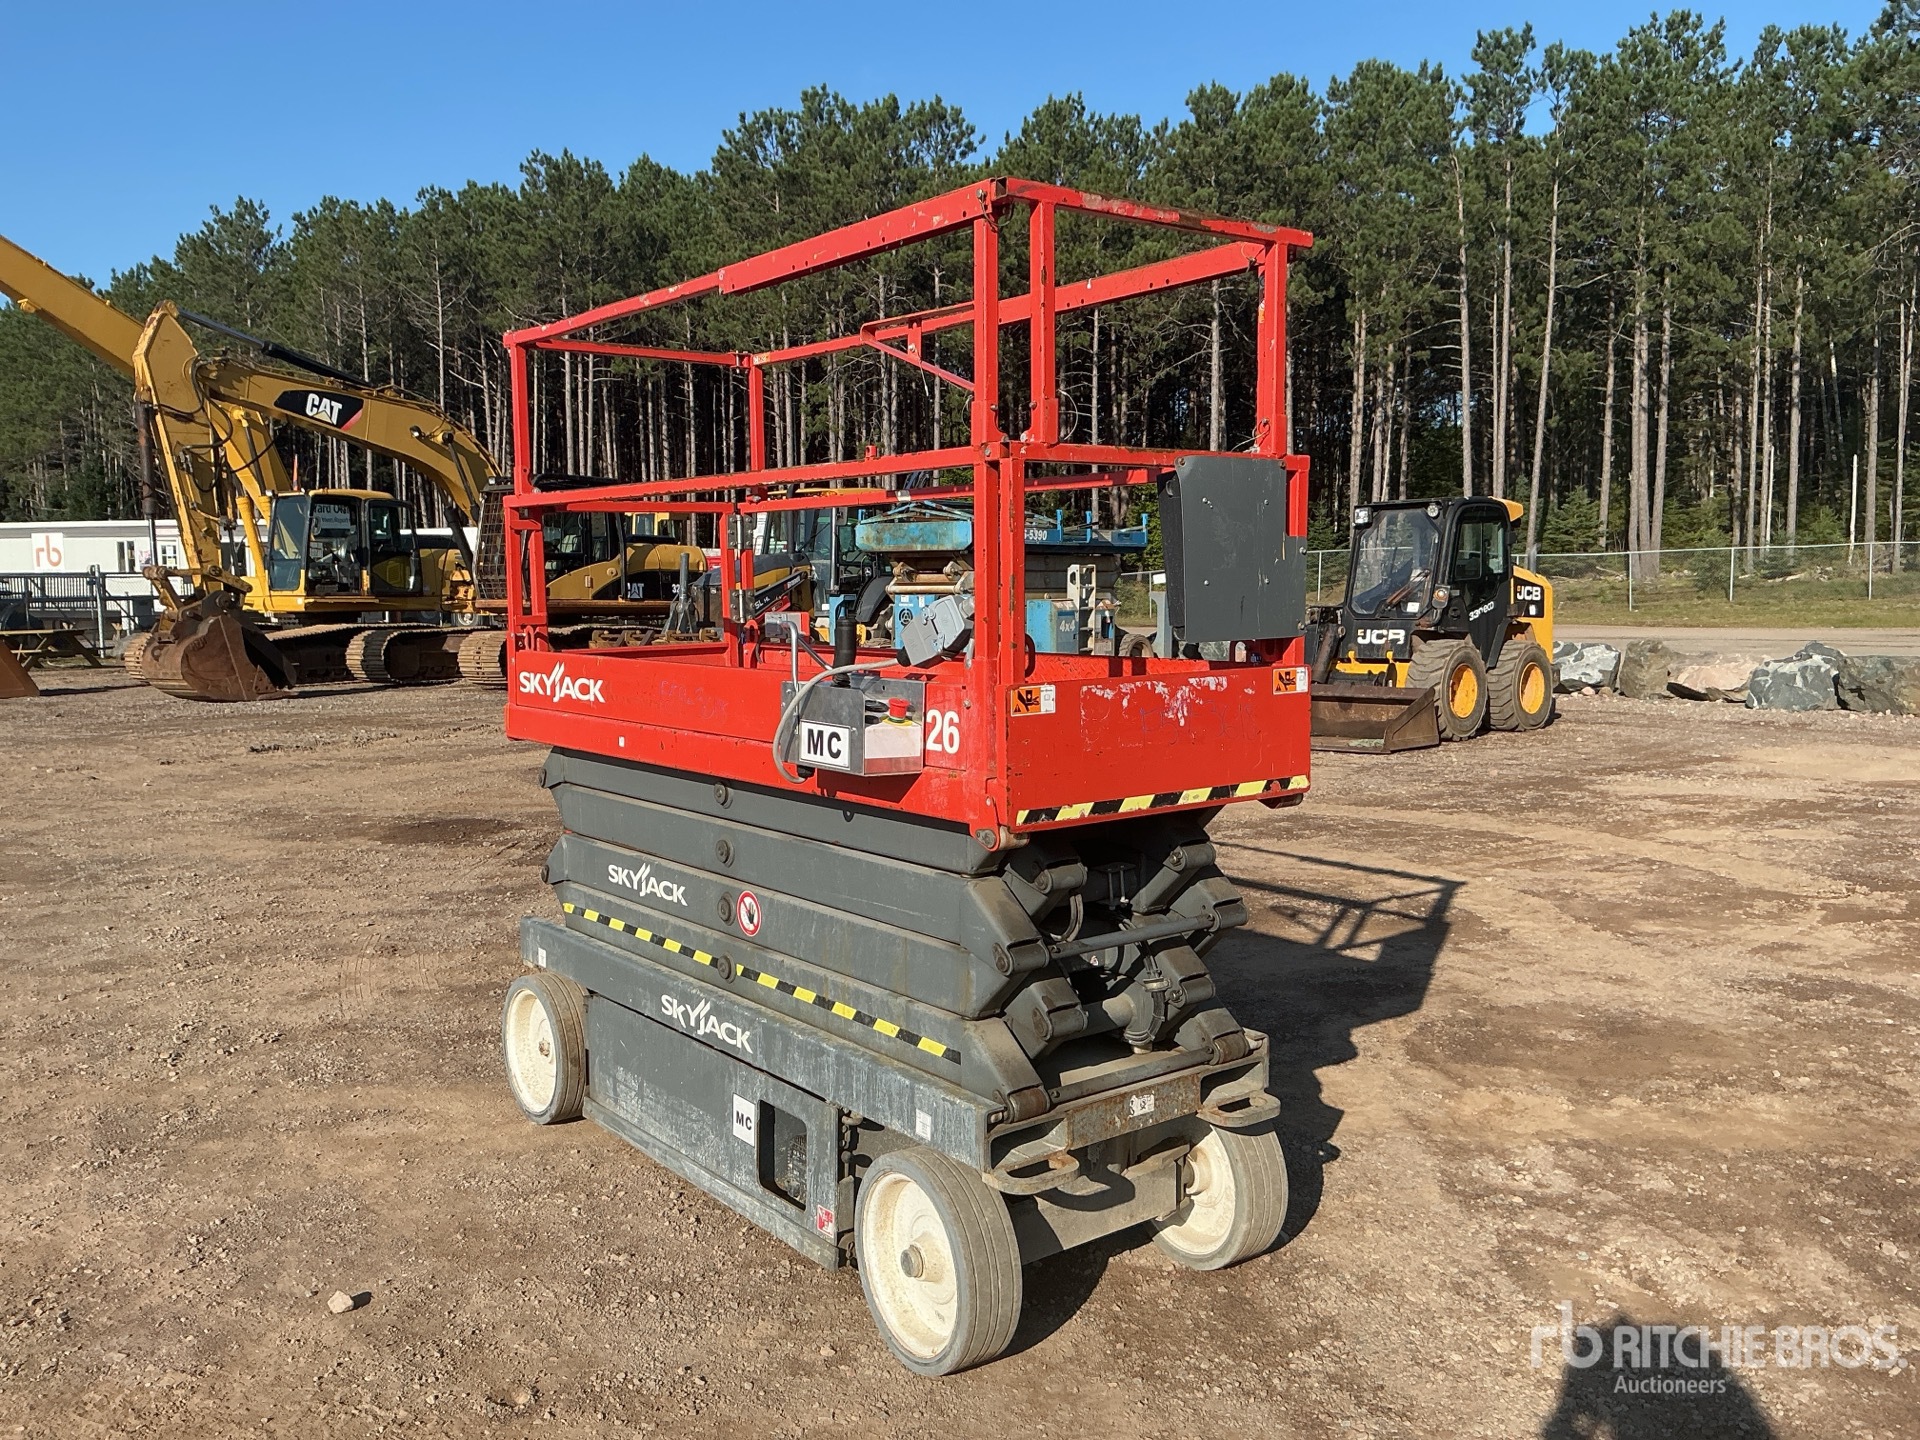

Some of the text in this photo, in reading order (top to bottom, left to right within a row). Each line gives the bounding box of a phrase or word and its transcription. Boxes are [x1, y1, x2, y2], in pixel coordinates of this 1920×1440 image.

[305, 393, 342, 425] CAT
[35, 535, 62, 567] rb
[627, 582, 644, 598] AT
[1516, 585, 1541, 600] JCB
[1059, 619, 1076, 632] 4x4
[1357, 628, 1406, 645] JCB
[519, 661, 605, 703] SKYJACK
[806, 728, 842, 759] MC
[926, 708, 960, 755] 26
[607, 861, 688, 907] SKYJACK
[660, 993, 753, 1053] SKYJACK
[735, 1110, 752, 1131] MC
